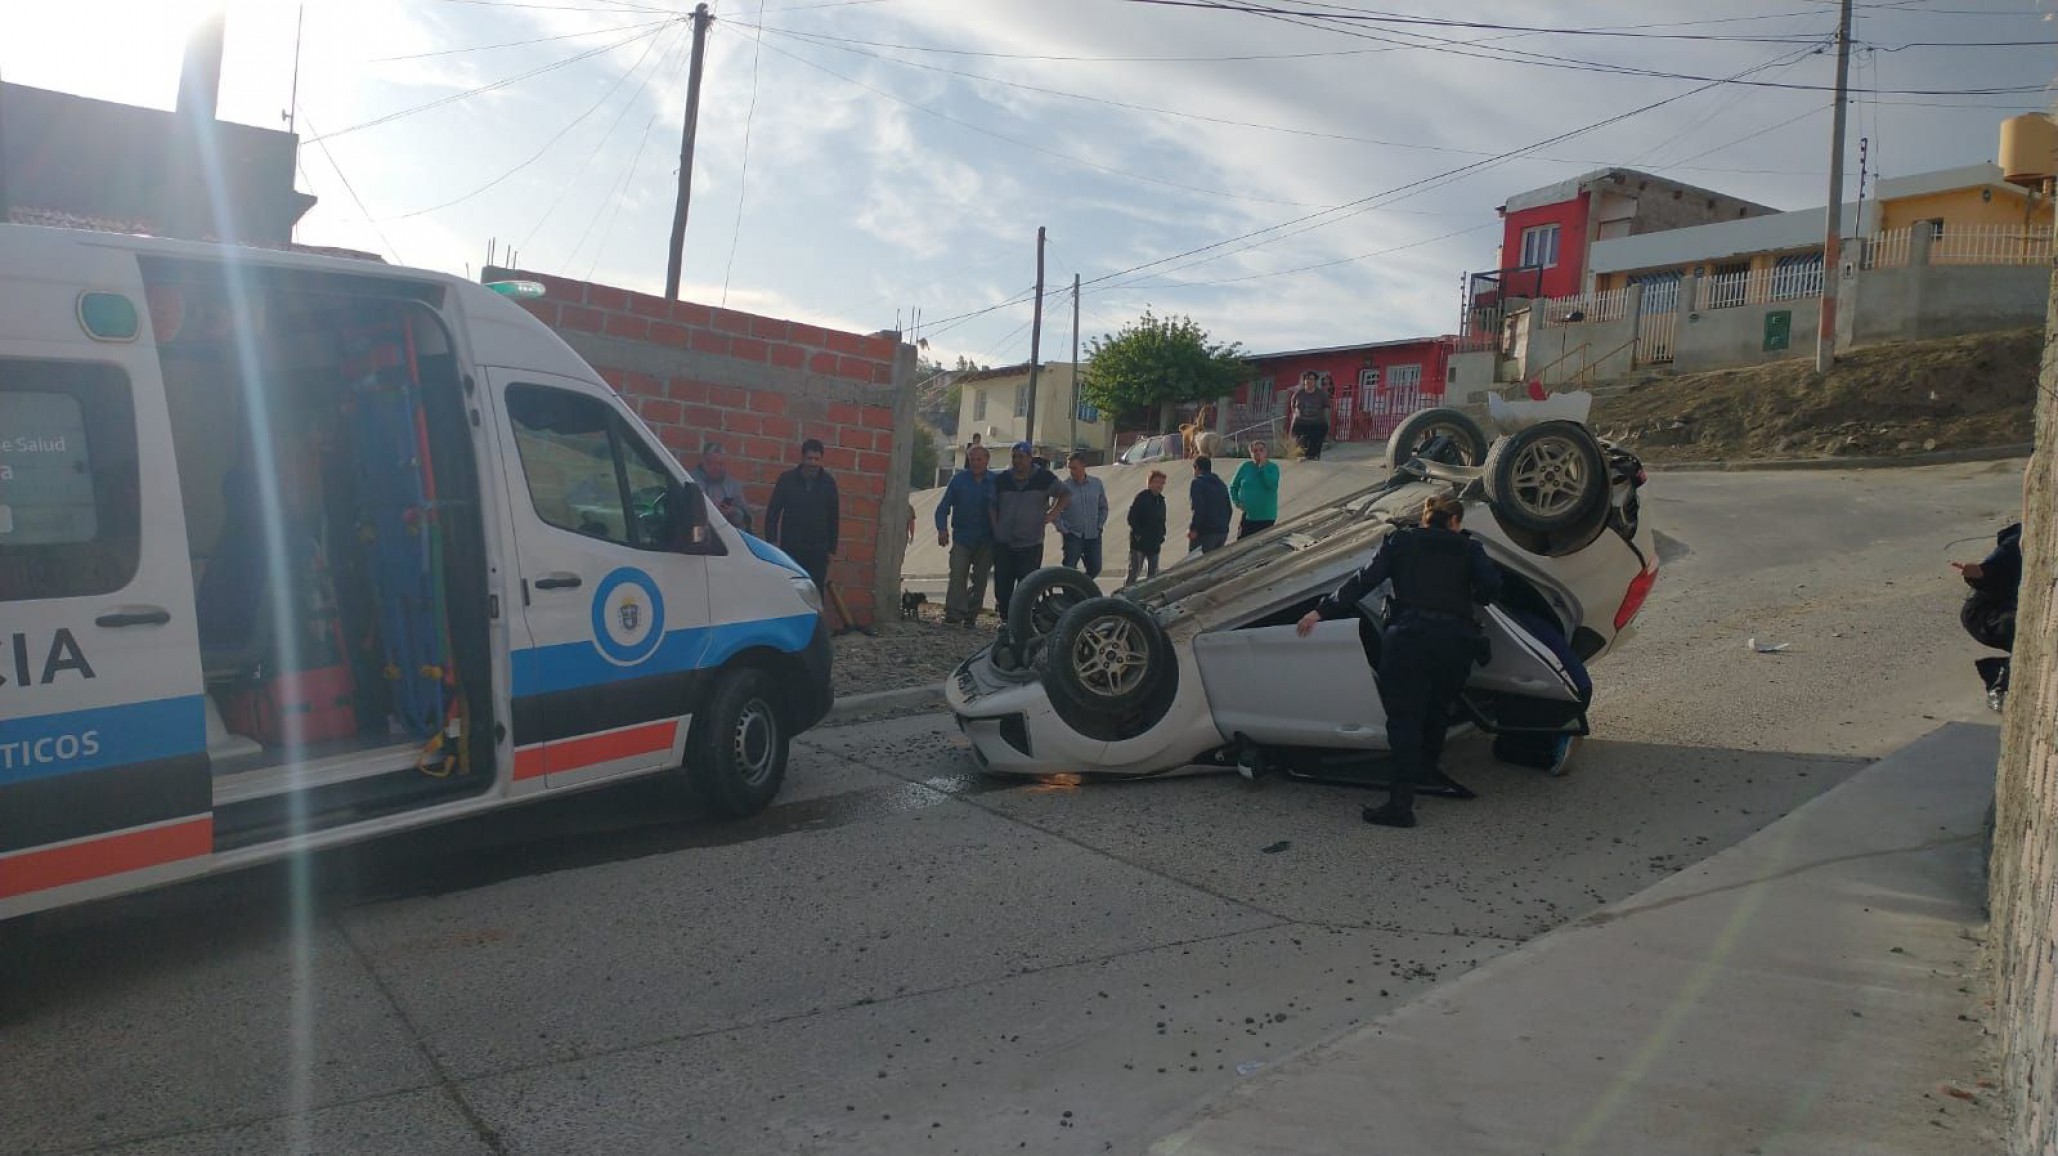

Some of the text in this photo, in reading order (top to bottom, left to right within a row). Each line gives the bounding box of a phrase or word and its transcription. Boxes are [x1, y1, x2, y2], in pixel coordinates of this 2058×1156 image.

[0, 436, 66, 452] e Salud
[0, 627, 97, 687] IA
[0, 730, 99, 769] TICOS
